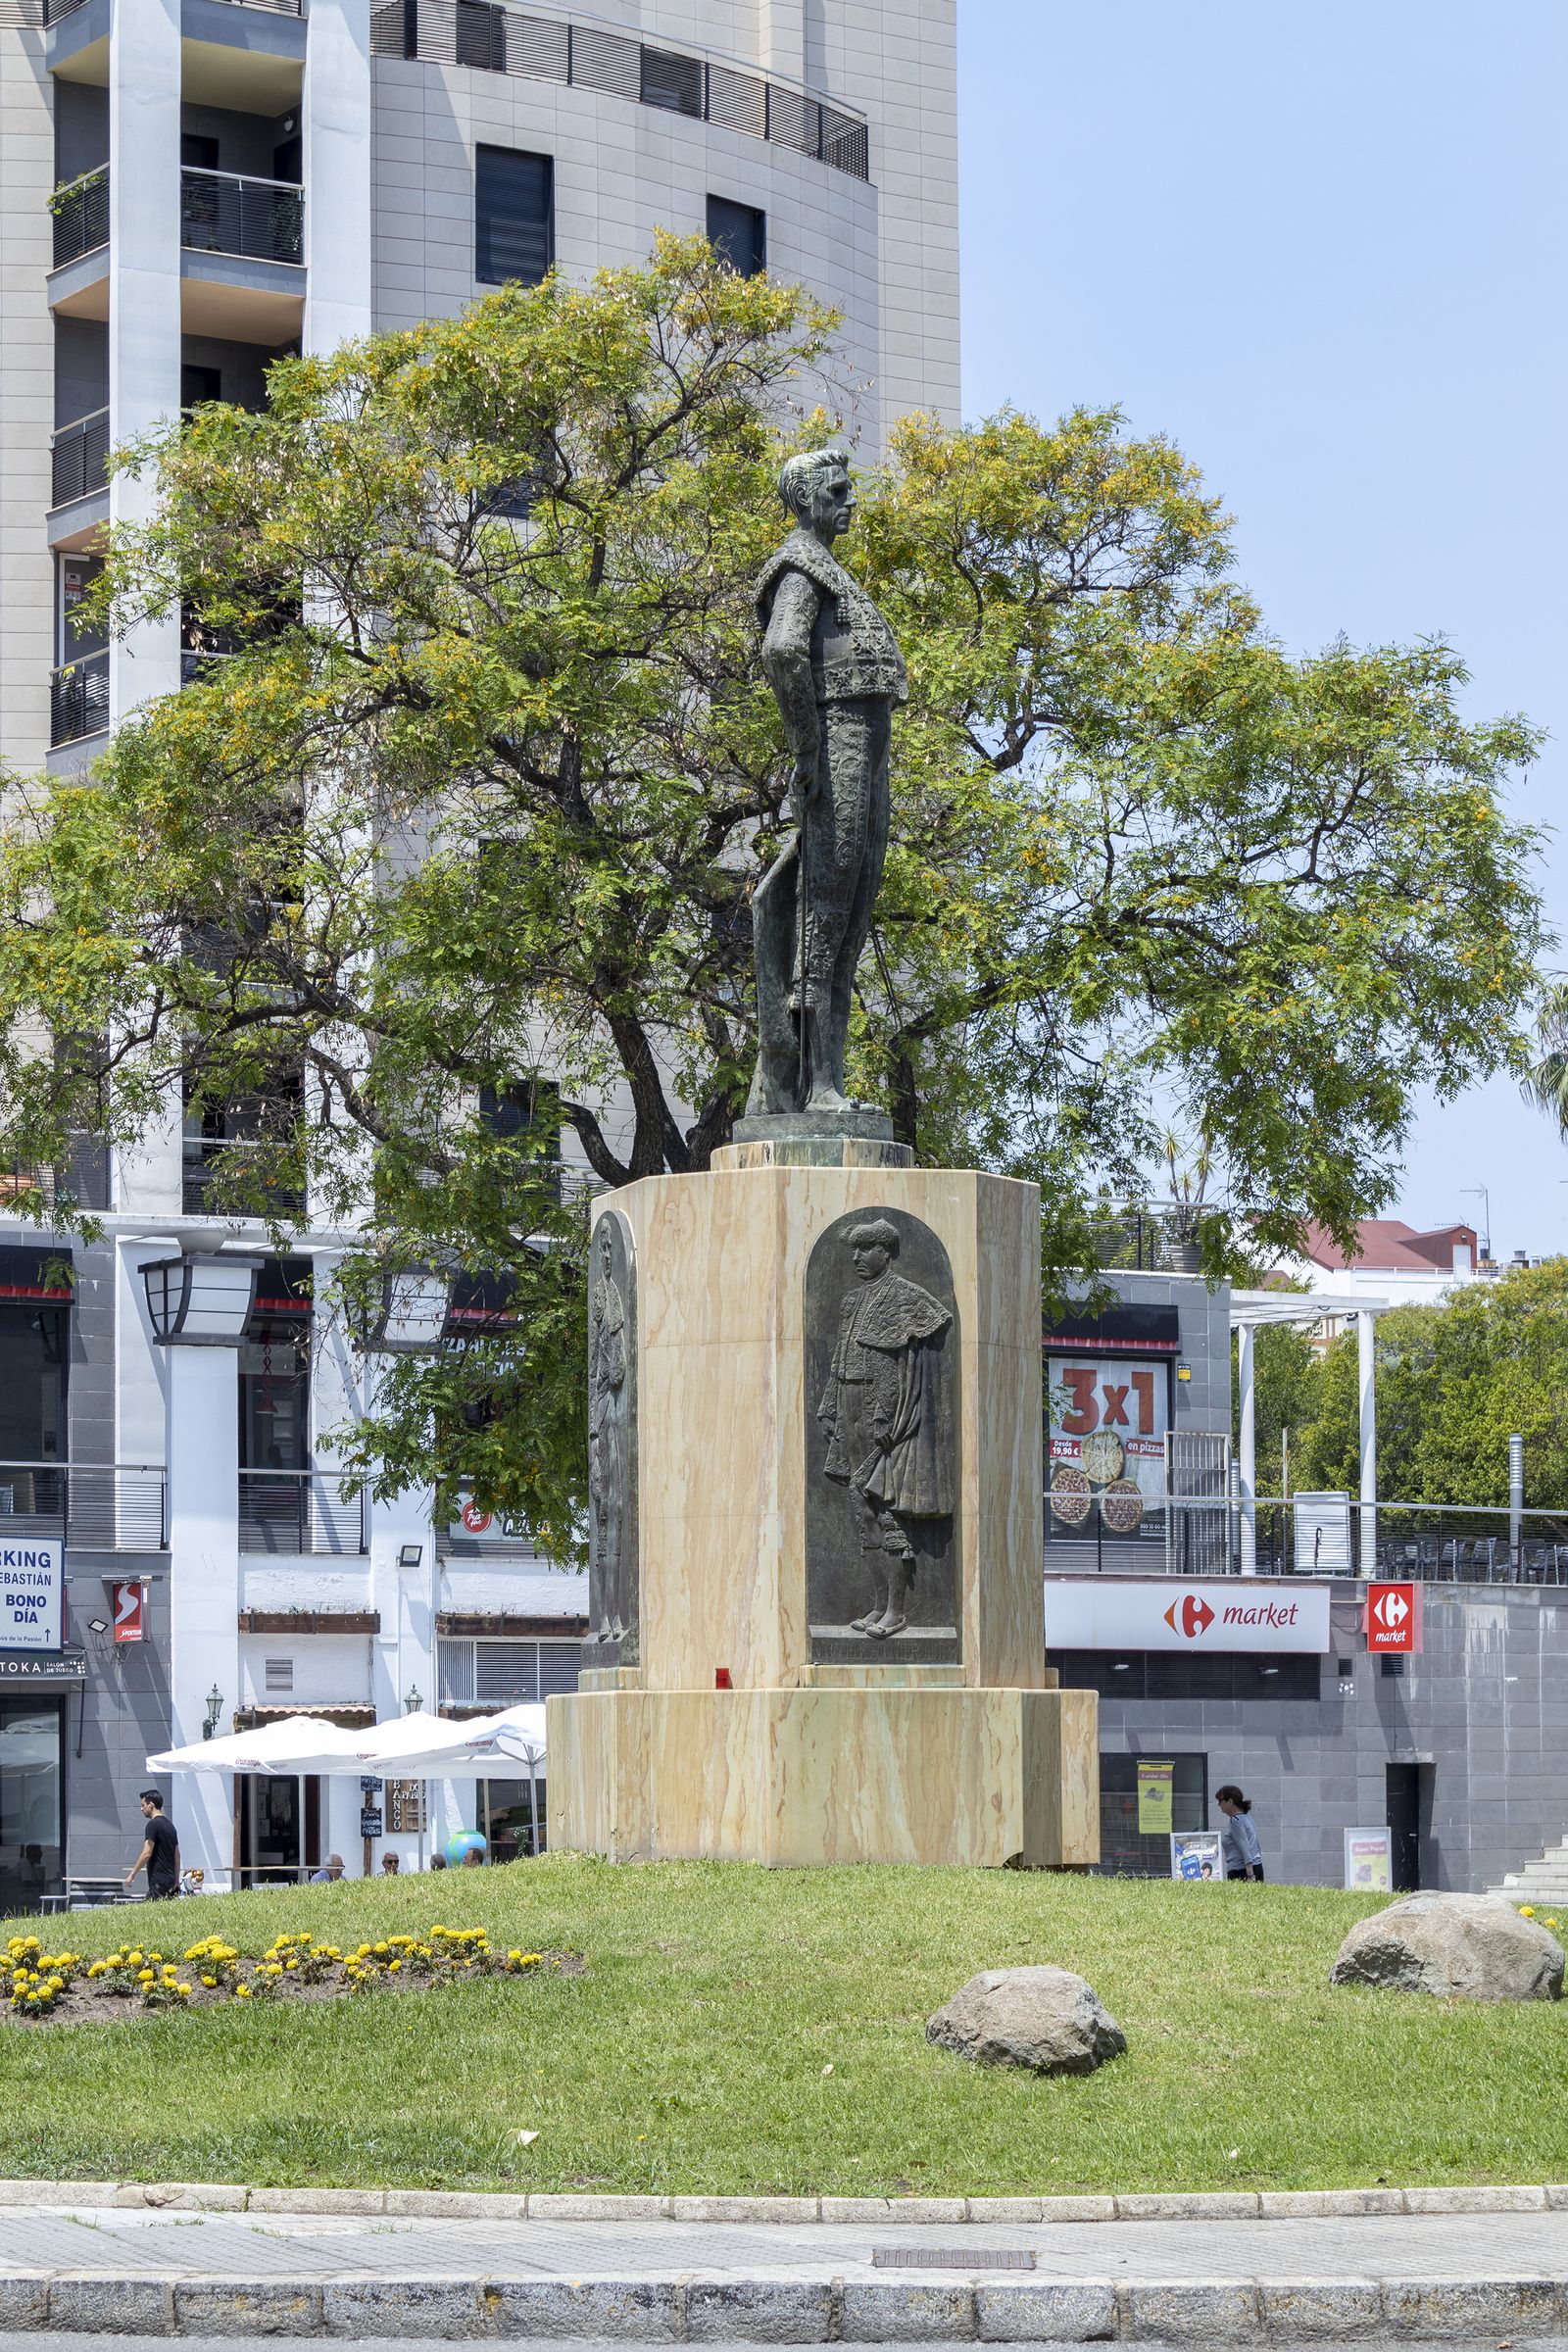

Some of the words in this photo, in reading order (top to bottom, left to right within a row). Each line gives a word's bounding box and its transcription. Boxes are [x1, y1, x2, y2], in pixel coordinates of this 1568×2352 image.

[1061, 1368, 1153, 1436] 3x1
[1052, 1446, 1073, 1456] 19,90
[1140, 1441, 1164, 1453] pizzas
[6, 1594, 47, 1608] BONO
[14, 1608, 38, 1624] DÍA
[1222, 1602, 1299, 1629] market
[1375, 1629, 1407, 1643] market
